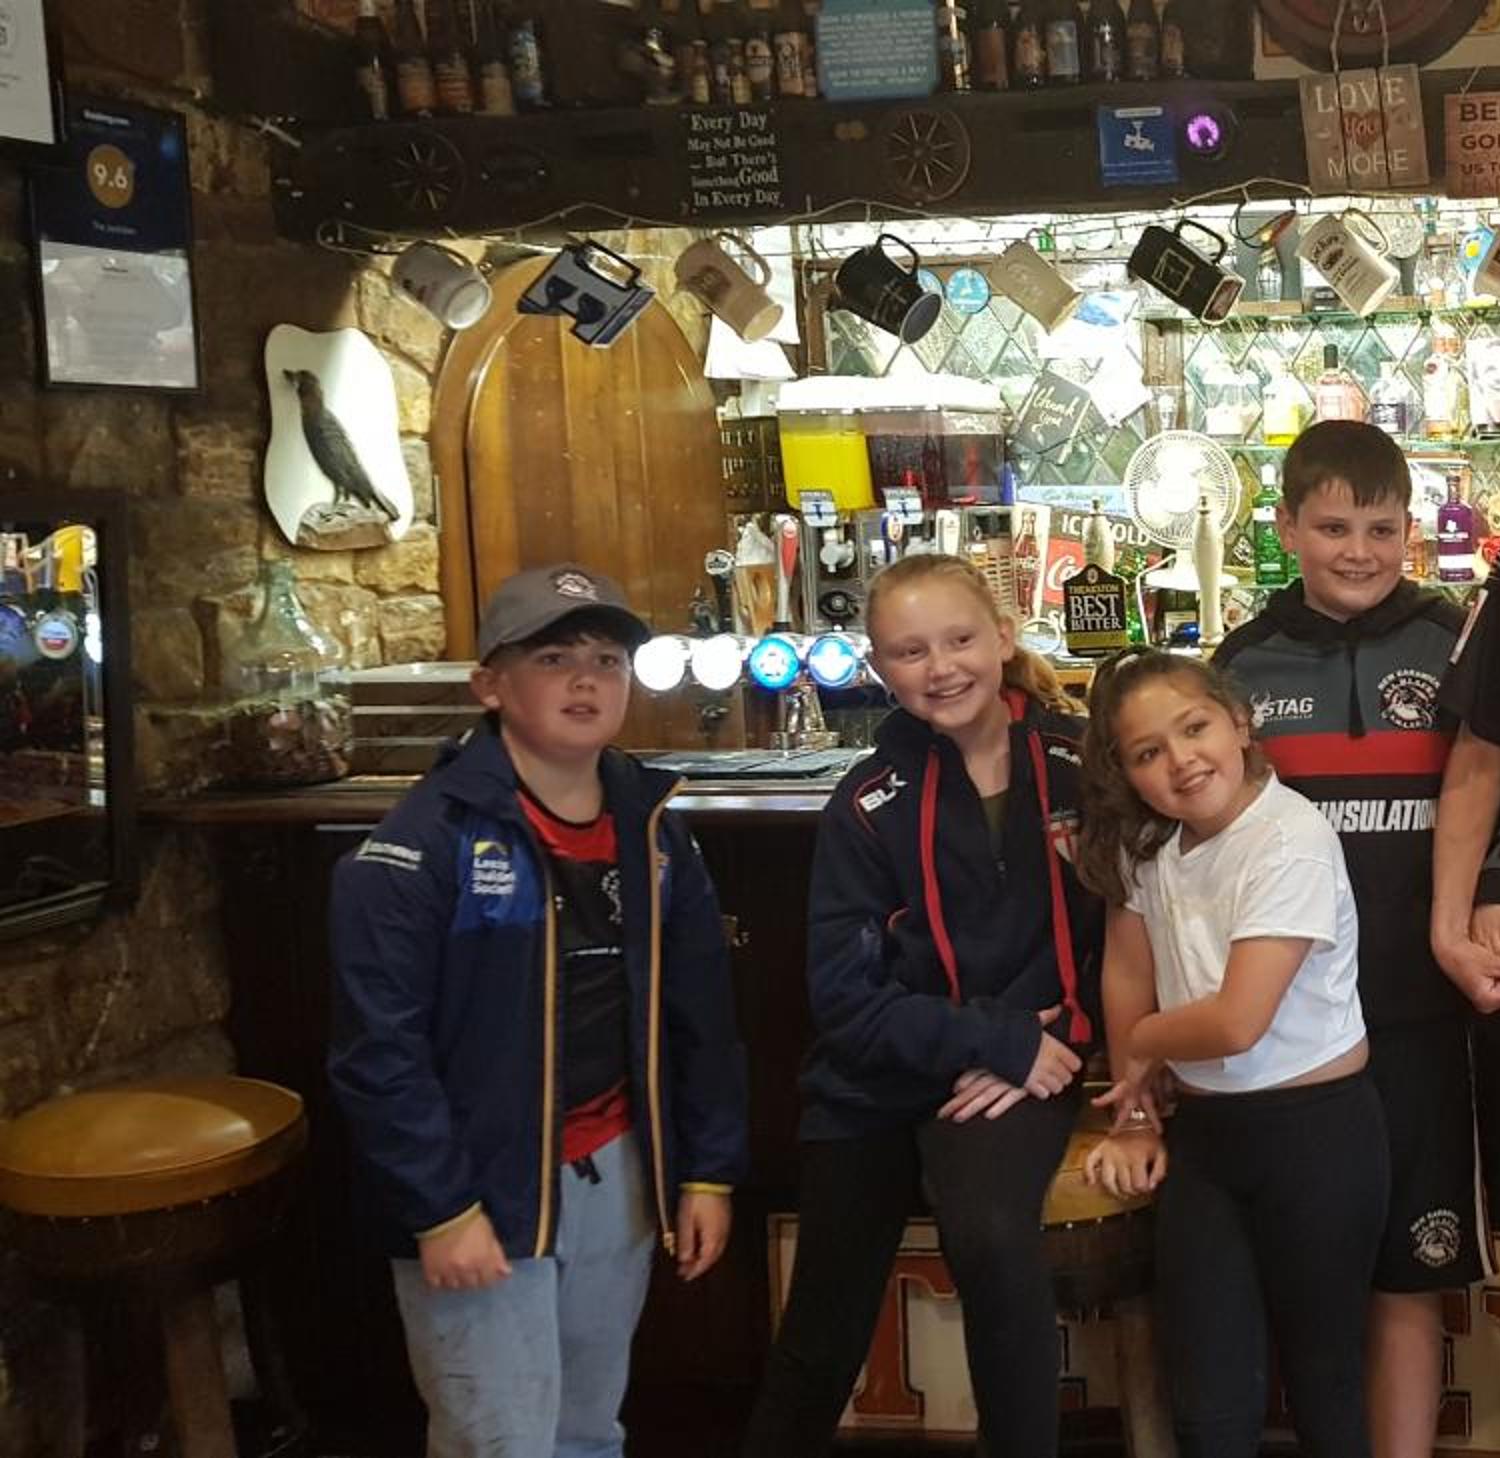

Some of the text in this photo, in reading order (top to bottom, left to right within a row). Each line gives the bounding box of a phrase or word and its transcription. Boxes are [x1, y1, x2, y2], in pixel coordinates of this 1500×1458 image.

[1316, 78, 1406, 112] LOVE
[691, 111, 767, 134] Every Day
[739, 165, 779, 185] Good
[1328, 149, 1409, 178] MORE
[1461, 163, 1484, 176] US
[94, 163, 128, 190] 9.6
[694, 189, 781, 209] In Every Day
[1108, 520, 1149, 547] OLD
[1069, 594, 1120, 619] BEST
[1071, 616, 1123, 632] BITTER
[1263, 697, 1313, 717] STAG
[859, 772, 907, 813] BLK
